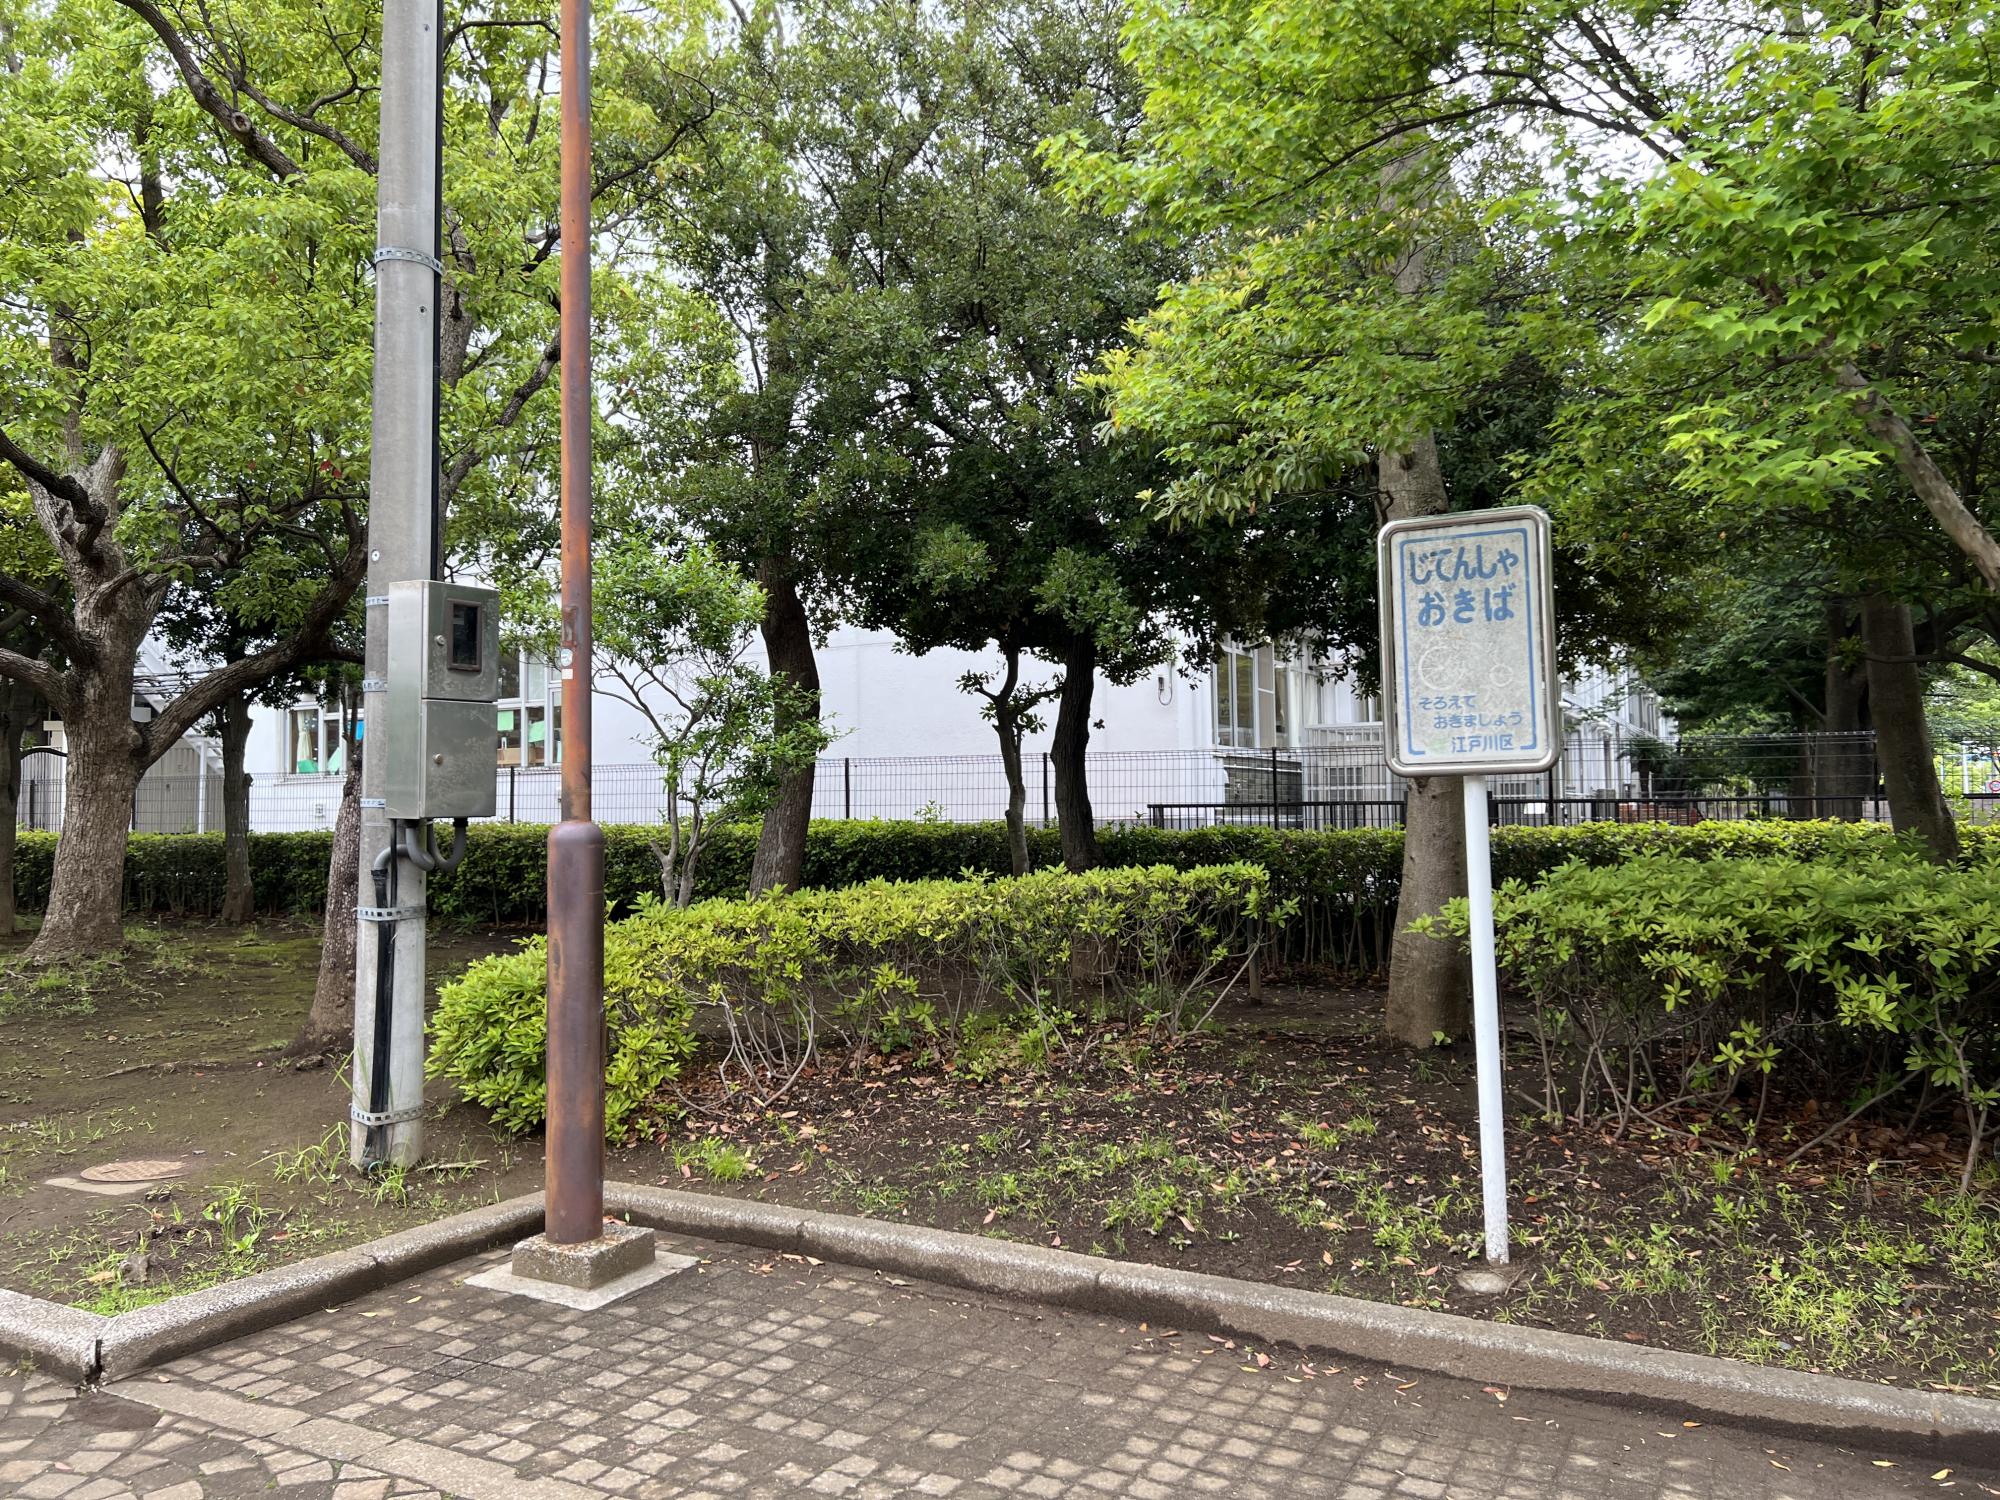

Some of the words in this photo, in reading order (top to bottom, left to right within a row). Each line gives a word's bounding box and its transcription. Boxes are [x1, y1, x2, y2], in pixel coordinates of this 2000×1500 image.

[1409, 544, 1519, 585] じてんしゃ
[1418, 582, 1517, 626] おきば
[1418, 695, 1476, 710] そろえて
[1433, 712, 1523, 729] おきましょう
[1452, 734, 1514, 753] 江戸川区
